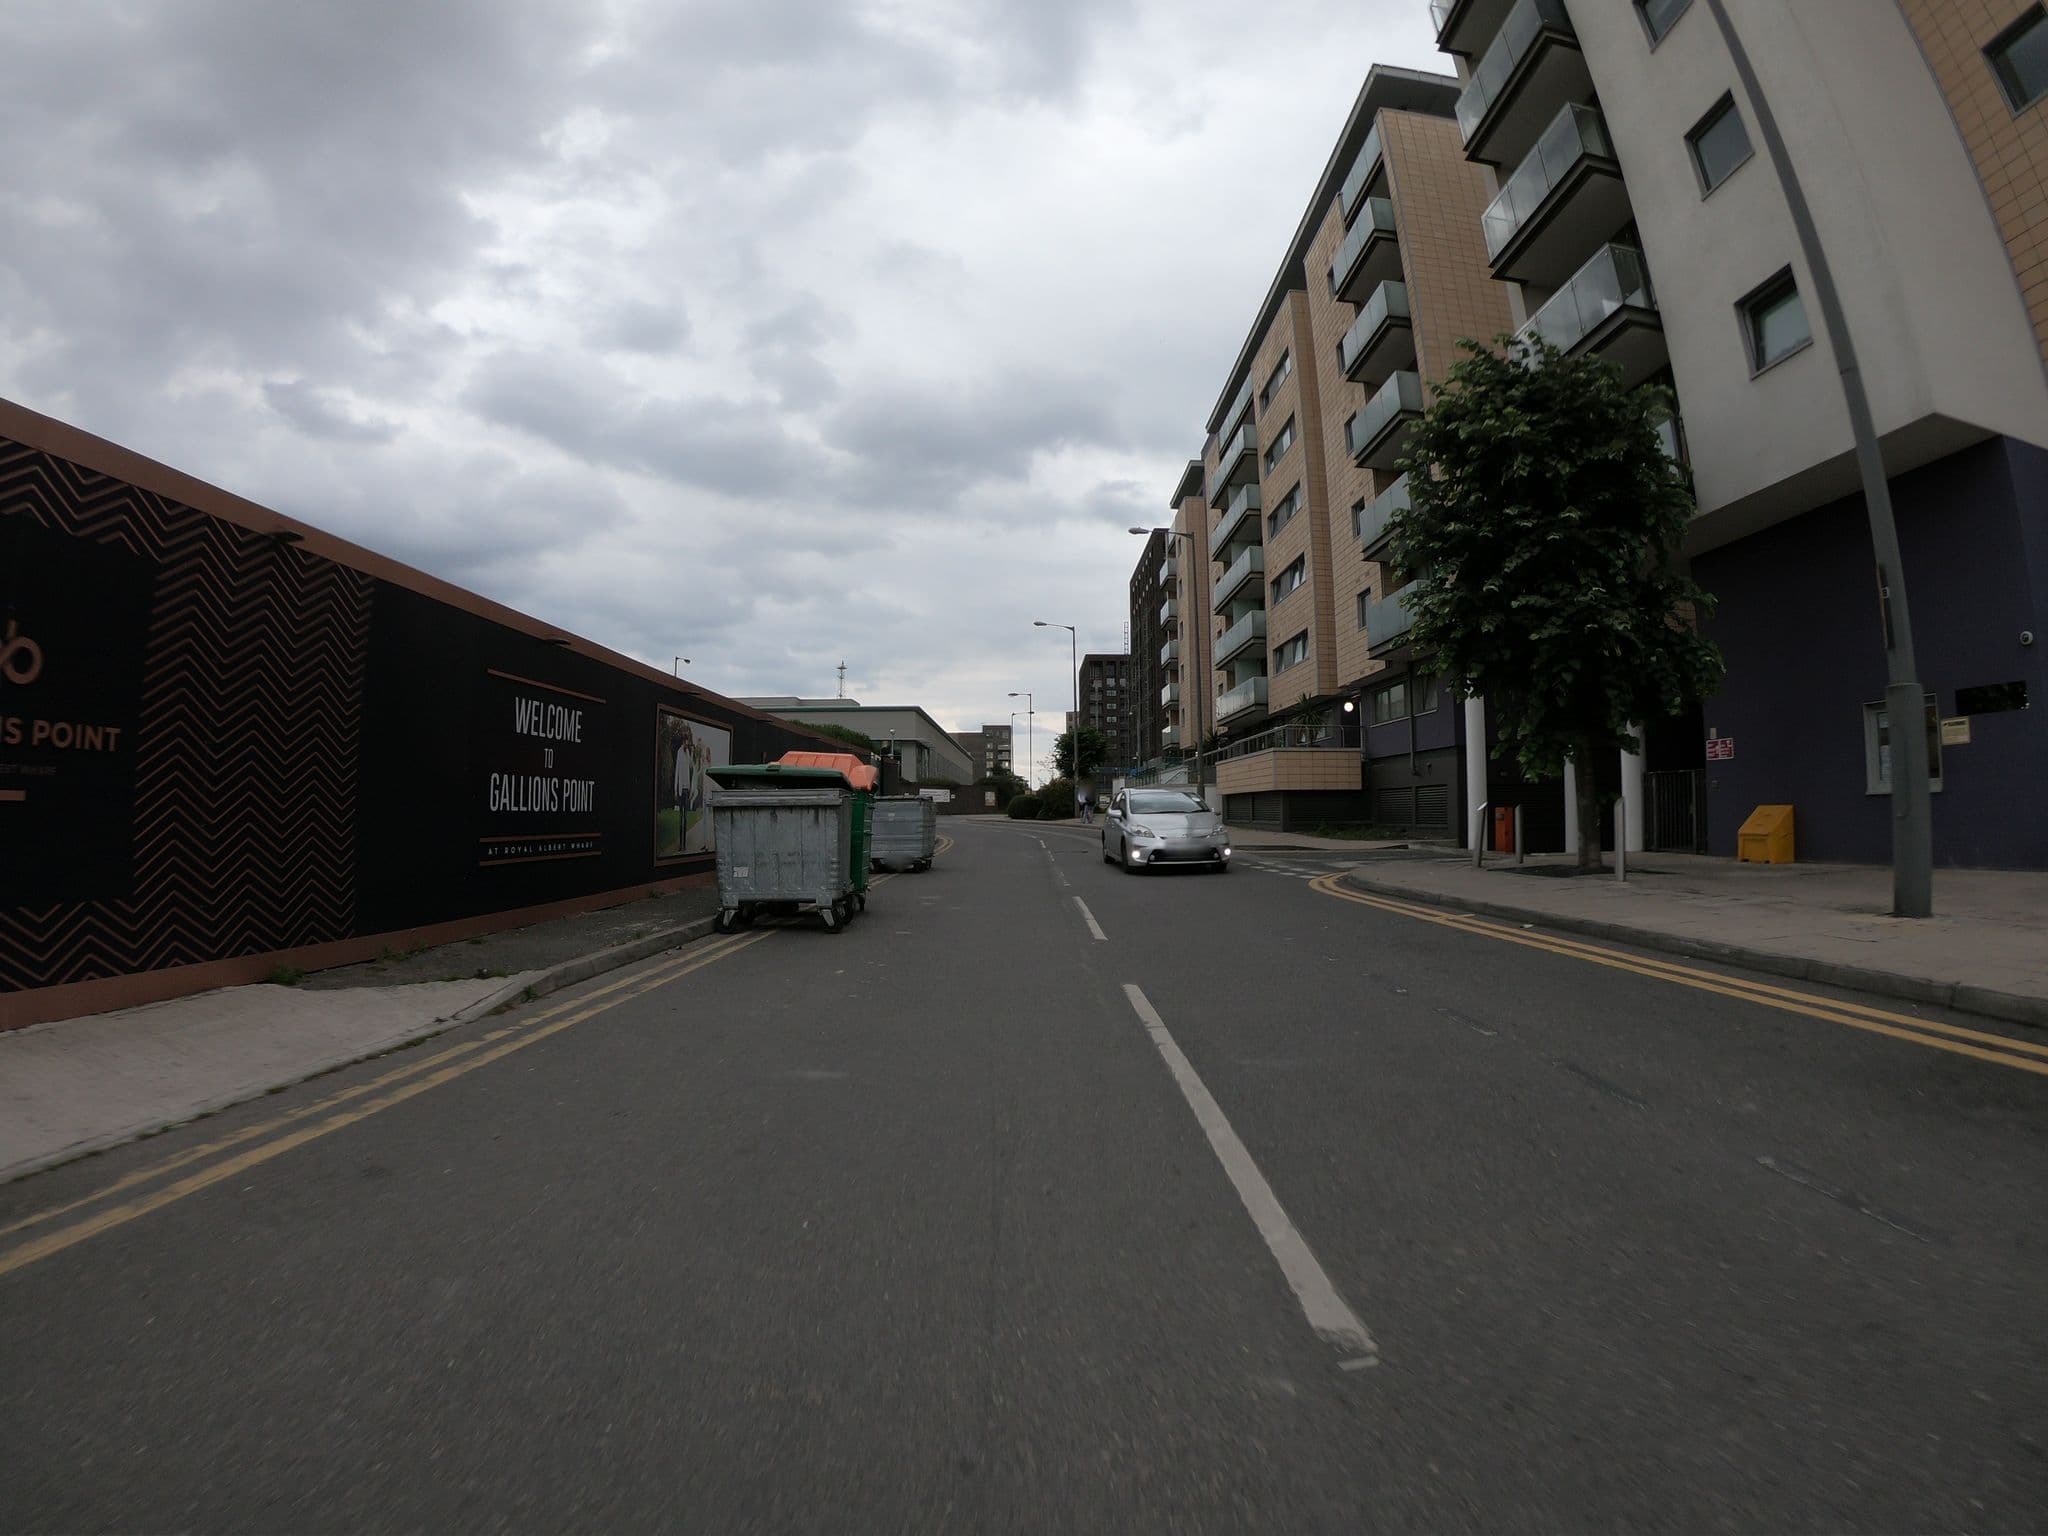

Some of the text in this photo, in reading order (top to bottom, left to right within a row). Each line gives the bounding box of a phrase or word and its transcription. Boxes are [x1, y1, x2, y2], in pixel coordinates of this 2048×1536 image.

[32, 719, 122, 752] POINT
[515, 696, 583, 743] WELCOME
[544, 748, 554, 768] TO
[489, 772, 595, 812] GALLIONS POINT
[488, 847, 498, 855] AT
[504, 846, 533, 855] ROYAL
